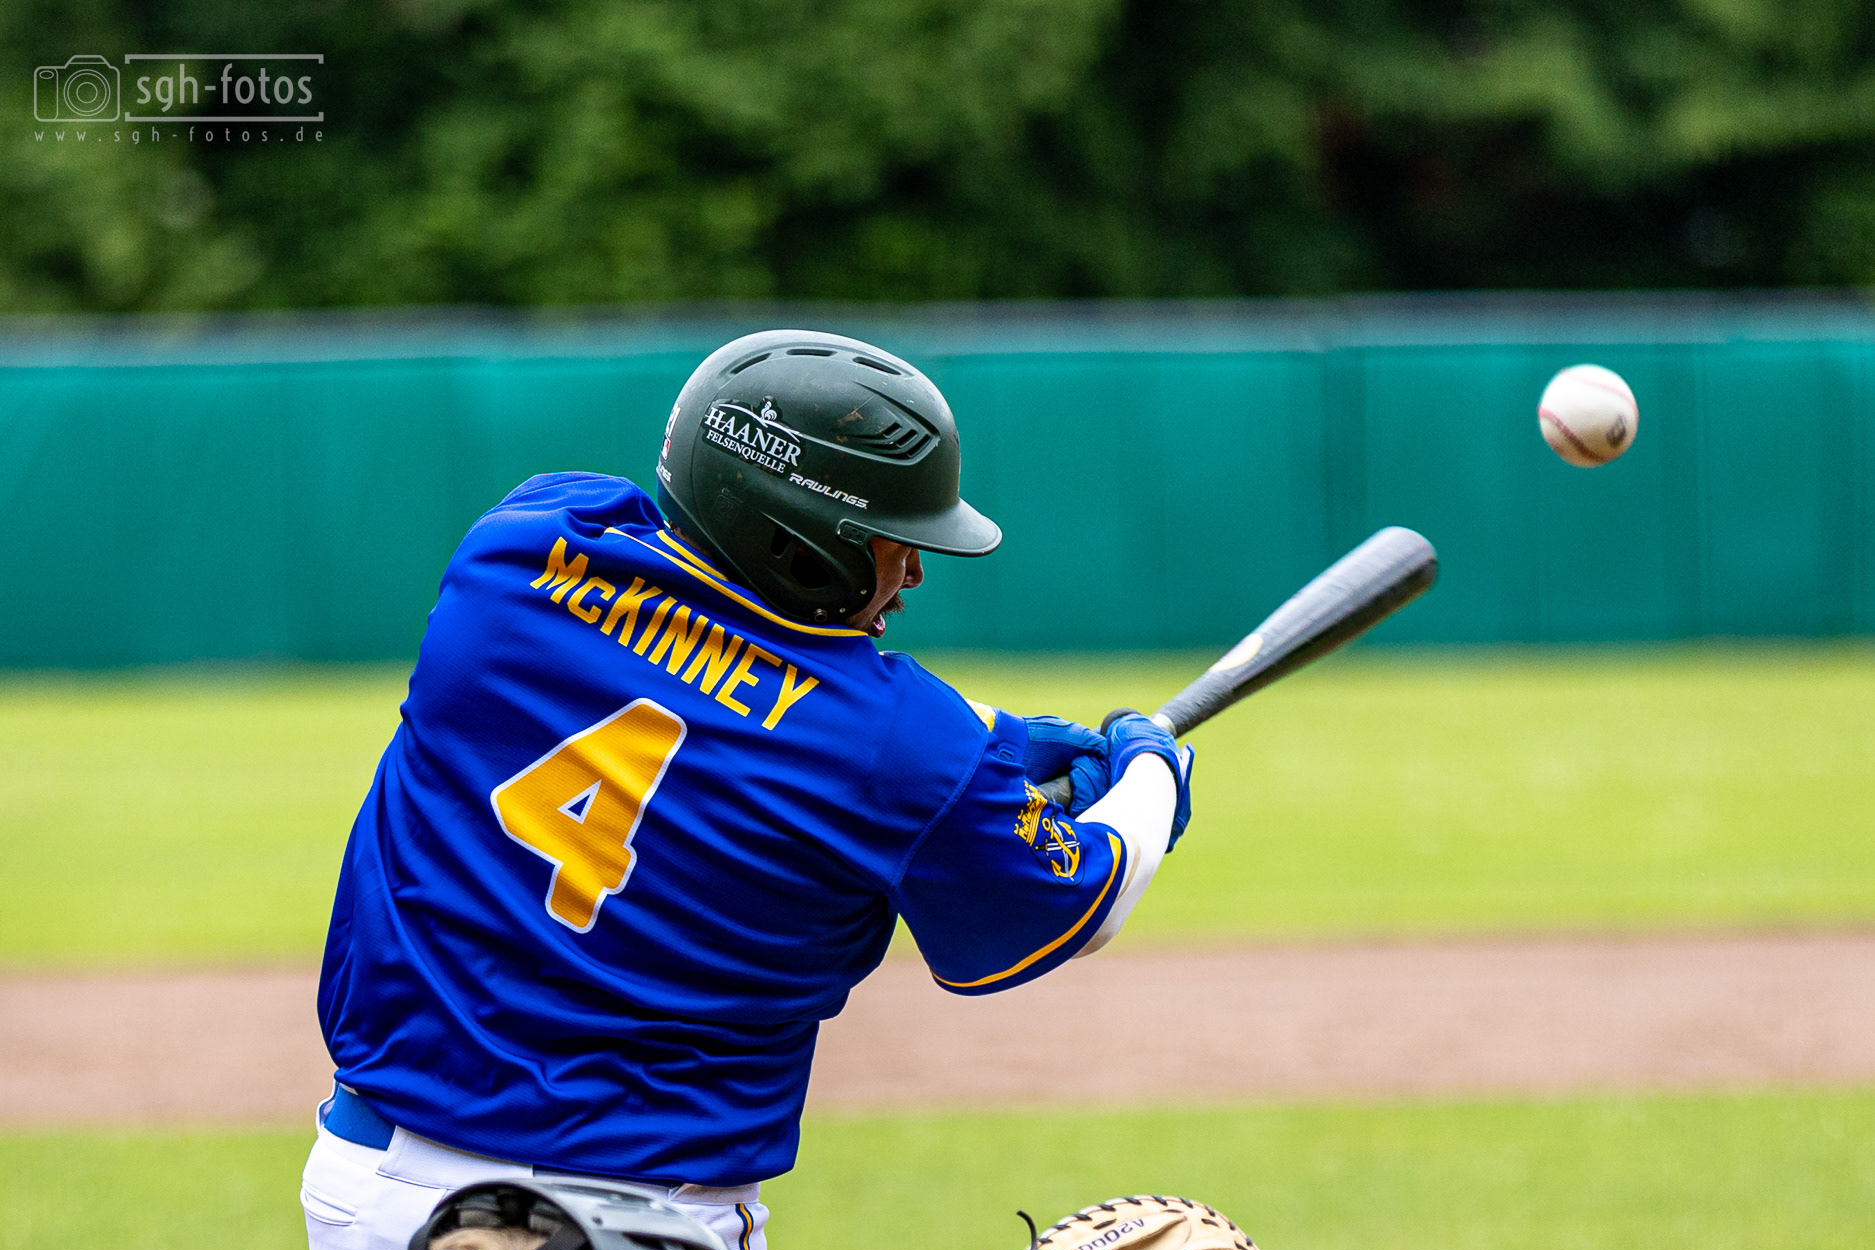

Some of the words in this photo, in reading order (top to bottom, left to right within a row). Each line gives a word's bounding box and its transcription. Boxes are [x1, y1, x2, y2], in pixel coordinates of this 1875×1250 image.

[704, 406, 802, 467] HAANER
[706, 429, 786, 474] FELSENQUELLE
[789, 472, 870, 509] RAWLINGS
[491, 697, 688, 934] 4
